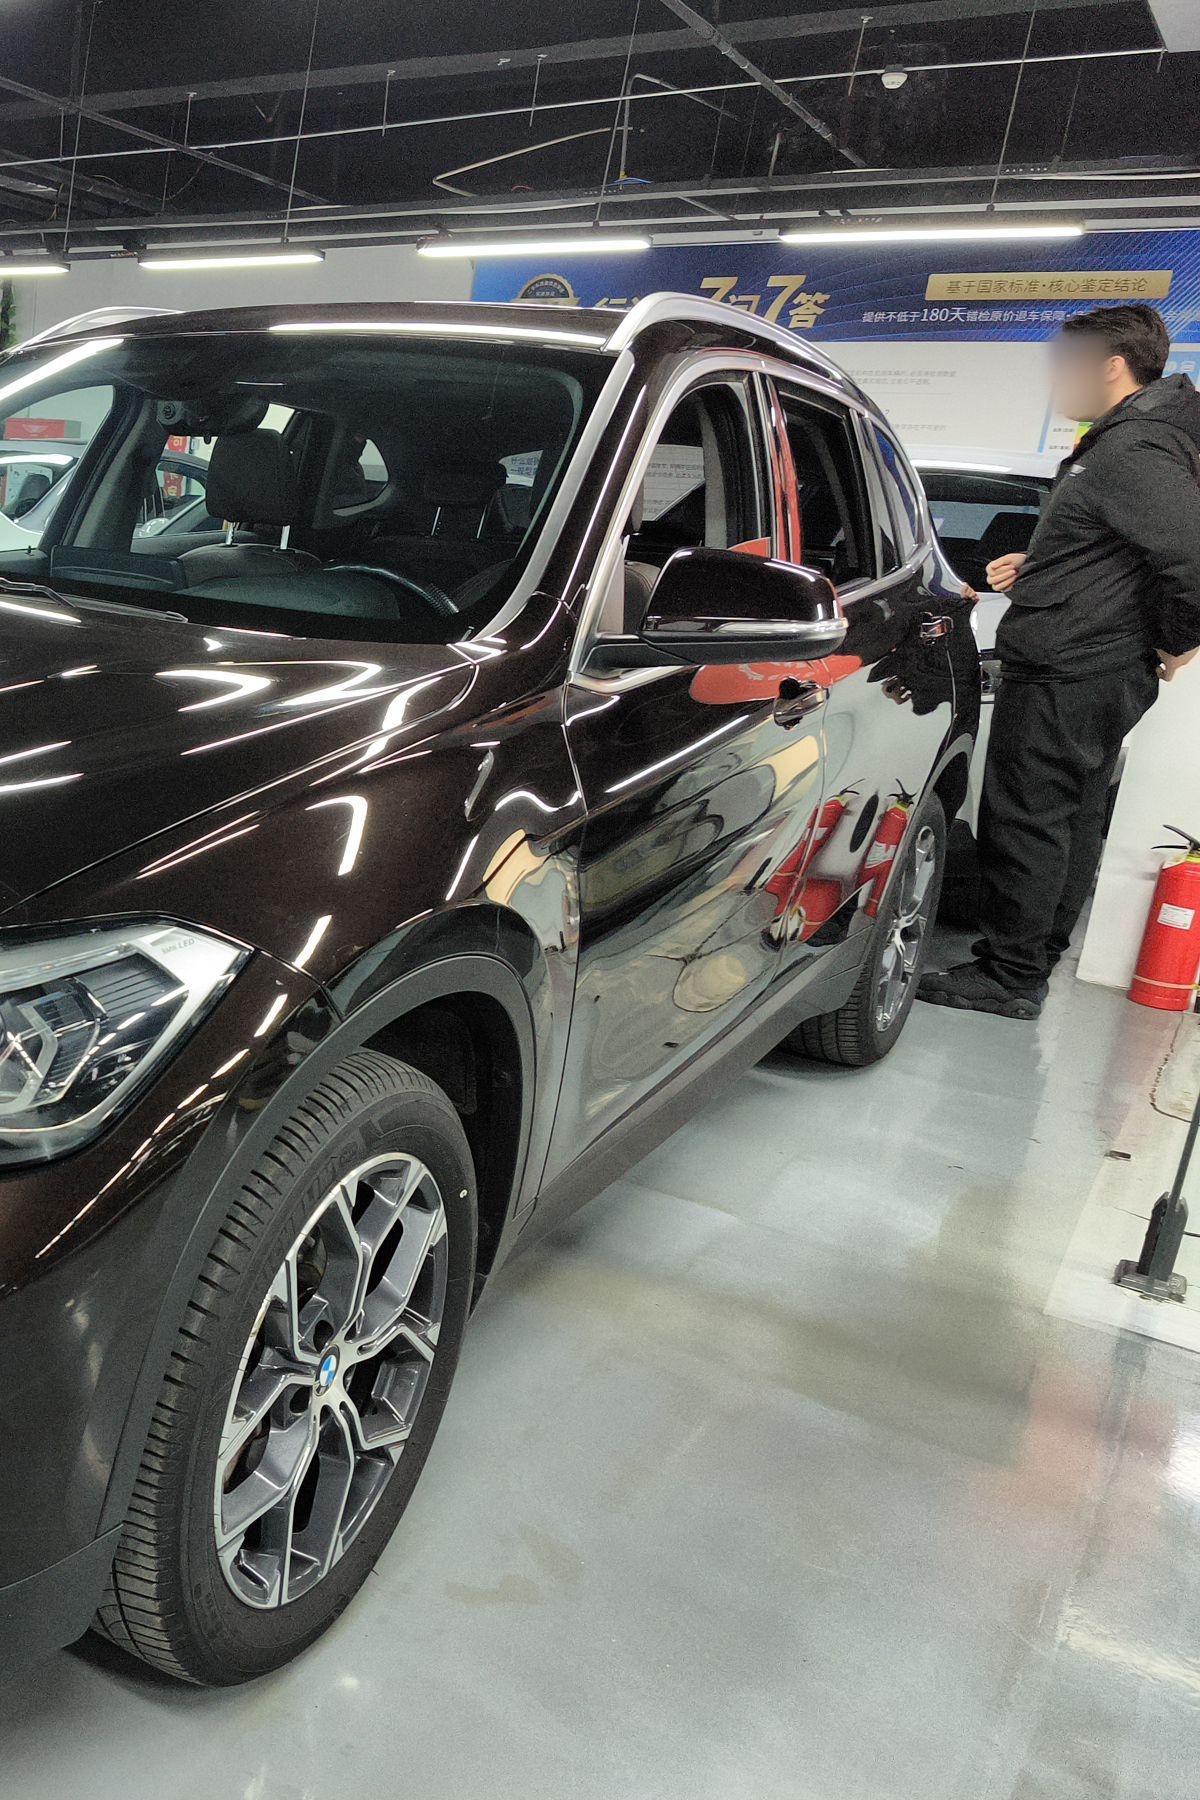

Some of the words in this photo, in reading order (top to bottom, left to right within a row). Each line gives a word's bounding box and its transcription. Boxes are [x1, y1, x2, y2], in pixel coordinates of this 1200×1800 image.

[946, 277, 1148, 294] 基于国家标准·核心鉴定结论
[862, 307, 1088, 322] 提供不低于180天错检原价退车保障·
